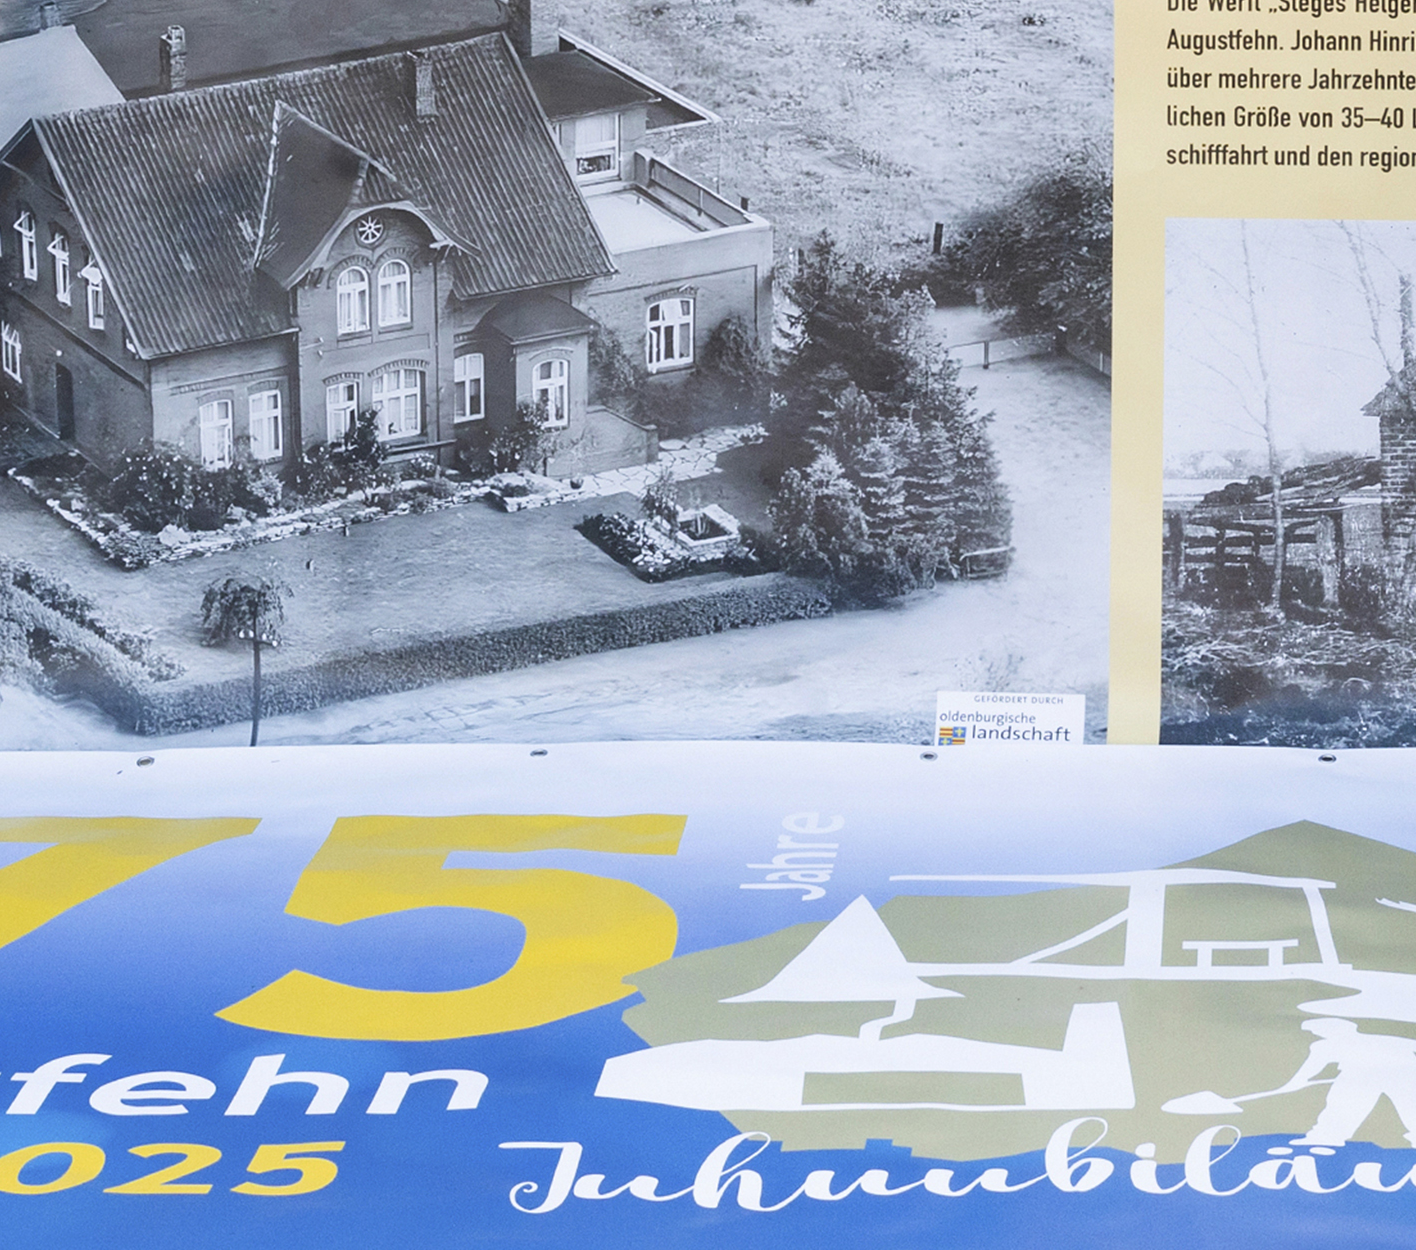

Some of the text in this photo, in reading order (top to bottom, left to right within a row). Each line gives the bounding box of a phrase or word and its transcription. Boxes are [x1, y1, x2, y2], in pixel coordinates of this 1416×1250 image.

[1166, 28, 1284, 56] Augustfehn.
[1290, 29, 1362, 52] Johann
[1167, 66, 1213, 89] über
[1218, 67, 1302, 90] mehrere
[1167, 104, 1226, 127] lichen
[1234, 105, 1291, 128] Größe
[1298, 111, 1333, 128] von
[1166, 143, 1269, 166] schifffahrt
[1274, 144, 1310, 167] und
[1317, 144, 1353, 167] den
[974, 694, 1064, 705] GEFÖRDERT DURCH
[939, 710, 1036, 727] oldenburgische
[972, 724, 1071, 742] landschaft
[739, 811, 845, 901] Jahre
